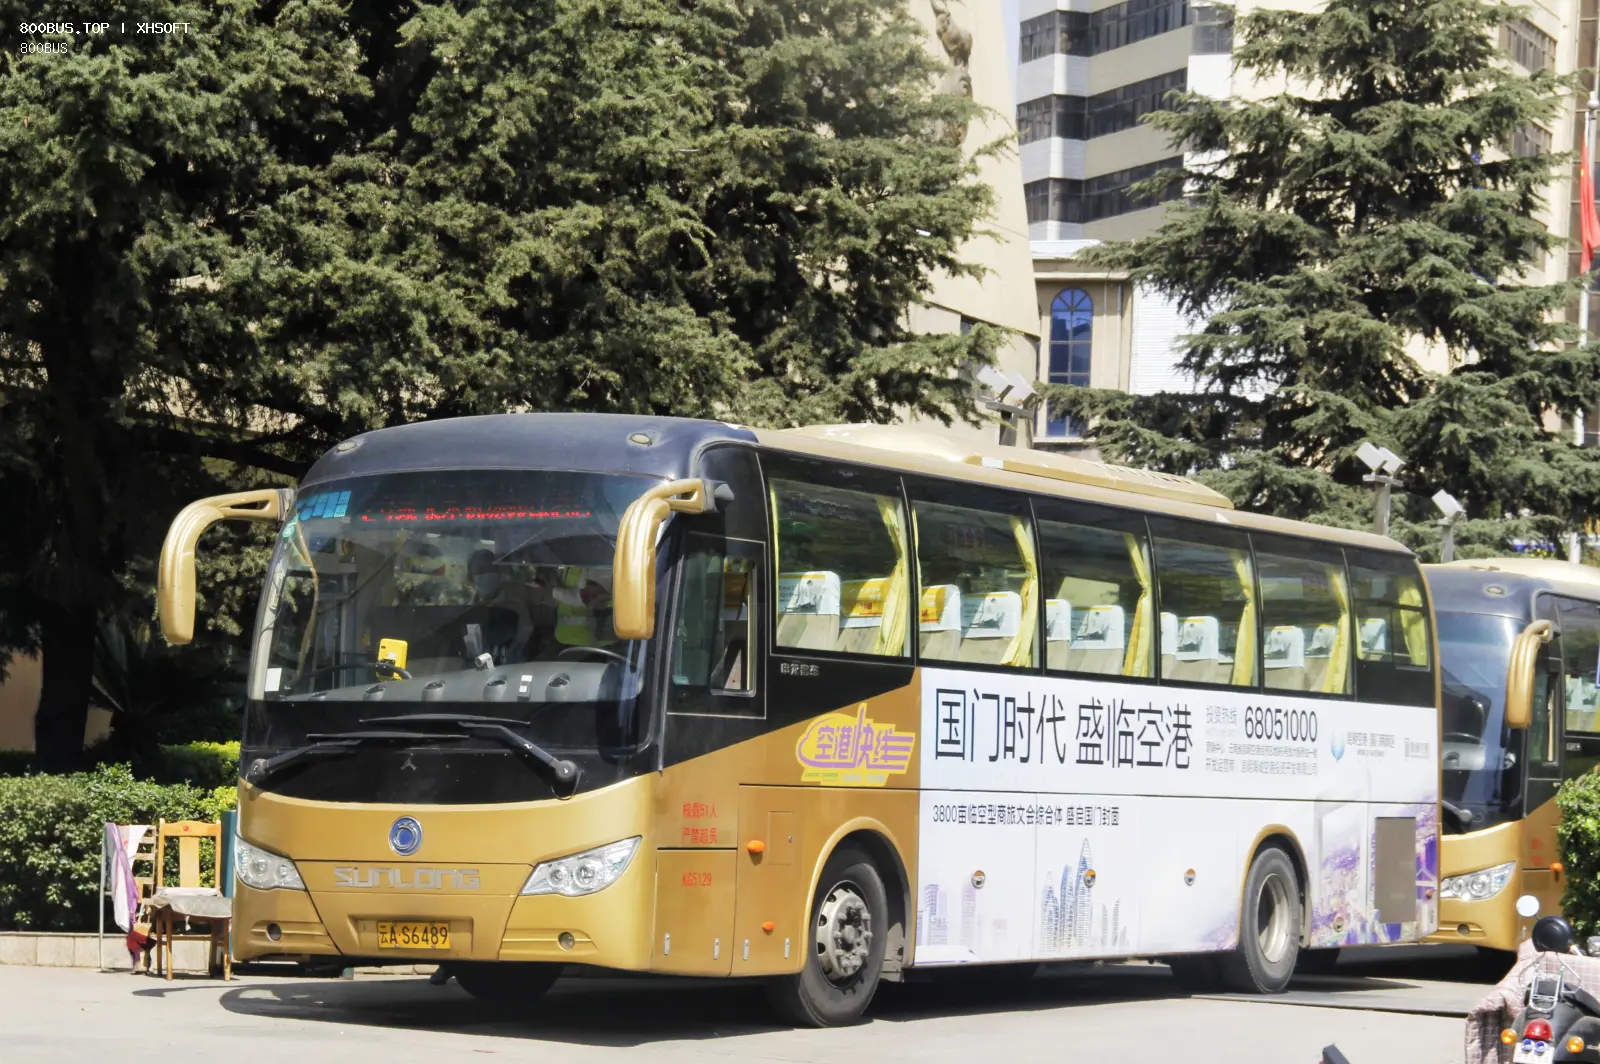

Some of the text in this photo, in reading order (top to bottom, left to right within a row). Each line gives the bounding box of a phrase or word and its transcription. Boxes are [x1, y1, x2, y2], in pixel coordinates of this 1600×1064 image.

[812, 706, 914, 770] 空港快线
[935, 688, 1193, 769] 国门时代 盛临空港
[1245, 705, 1318, 742] 68051000
[933, 804, 1119, 826] 3800亩临空型商旅文会综合体 盛启国门封面
[334, 866, 480, 889] SUNLONG
